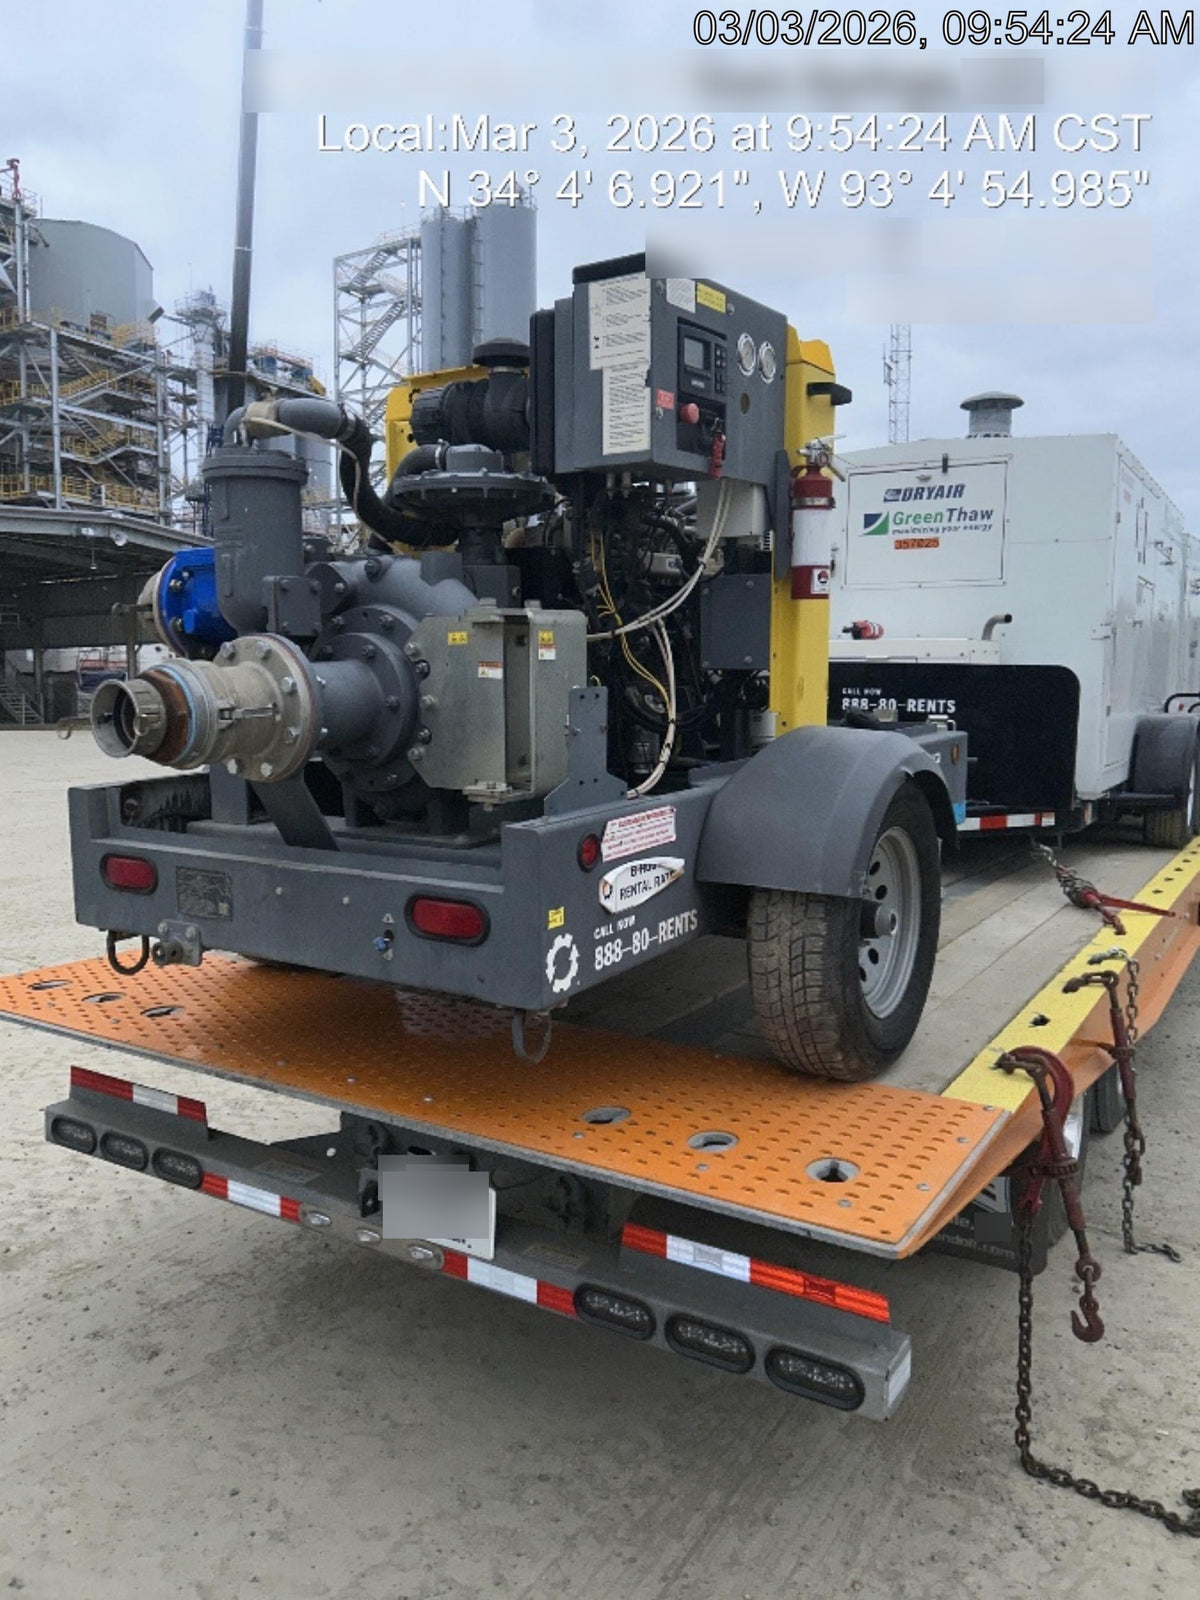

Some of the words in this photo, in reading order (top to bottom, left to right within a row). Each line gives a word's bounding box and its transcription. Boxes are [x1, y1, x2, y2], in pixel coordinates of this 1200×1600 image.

[901, 483, 965, 502] DRYAIR
[863, 688, 882, 696] NOW
[842, 698, 956, 714] 888-80-RENTS
[593, 923, 614, 940] CALL
[594, 908, 698, 971] 888-80-RENTS
